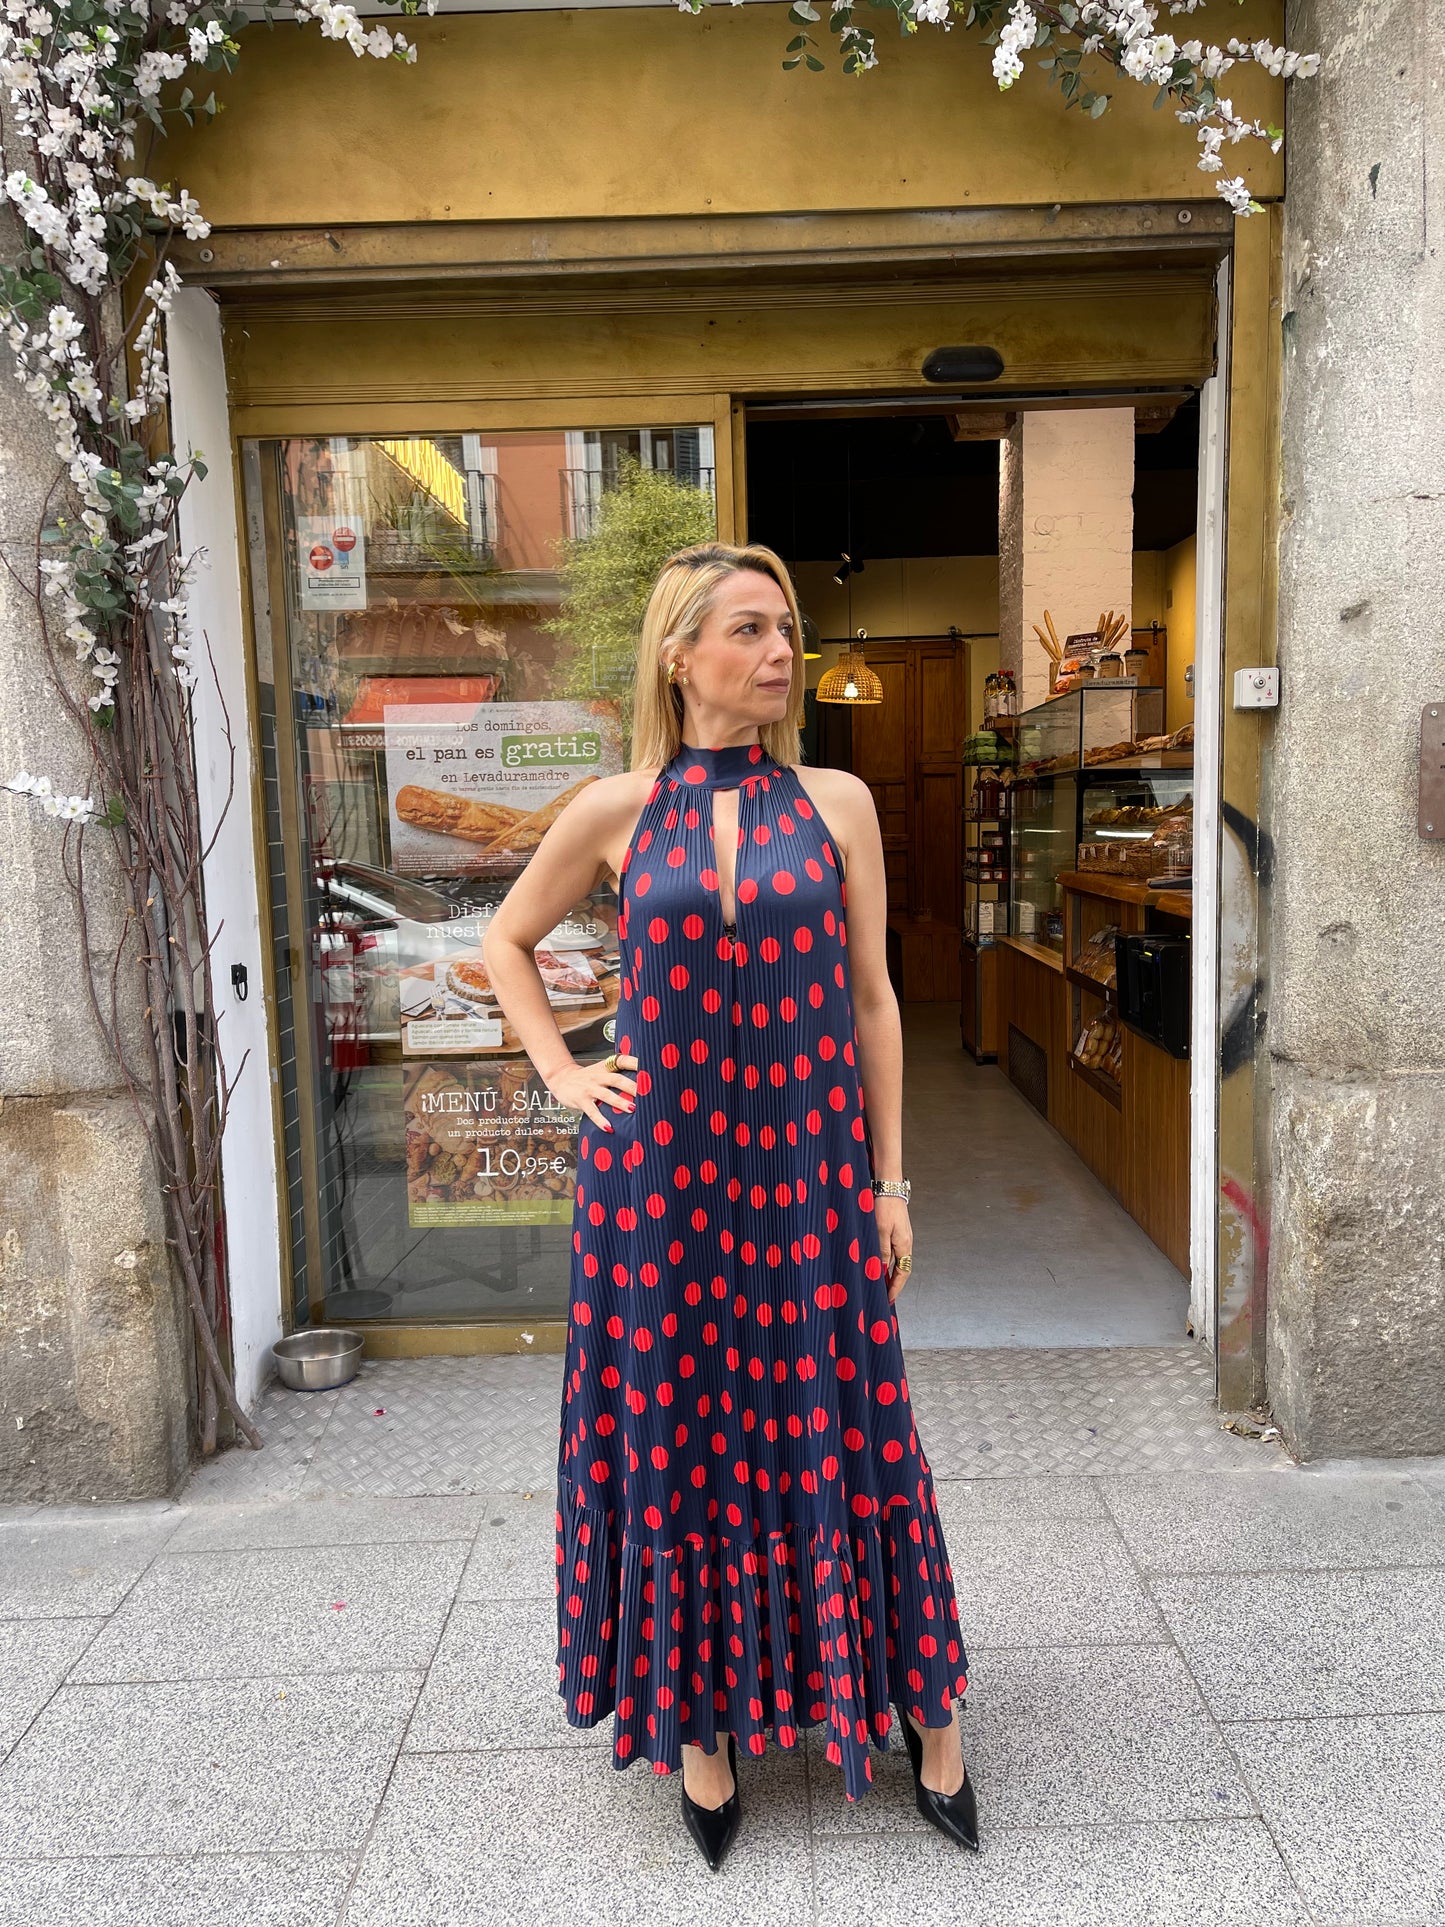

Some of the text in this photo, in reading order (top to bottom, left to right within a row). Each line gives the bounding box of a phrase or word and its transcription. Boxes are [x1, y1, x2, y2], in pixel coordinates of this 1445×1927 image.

[455, 720, 552, 734] Los domingos,
[405, 736, 597, 766] el pan es gratis
[441, 770, 570, 783] en Levaduramadre
[421, 1086, 567, 1113] ¡MENÚ SAL
[456, 1115, 575, 1126] Dos productos salados
[447, 1129, 461, 1137] un
[464, 1128, 511, 1138] producto
[514, 1127, 544, 1136] dulce
[476, 1147, 567, 1177] 10,95€
